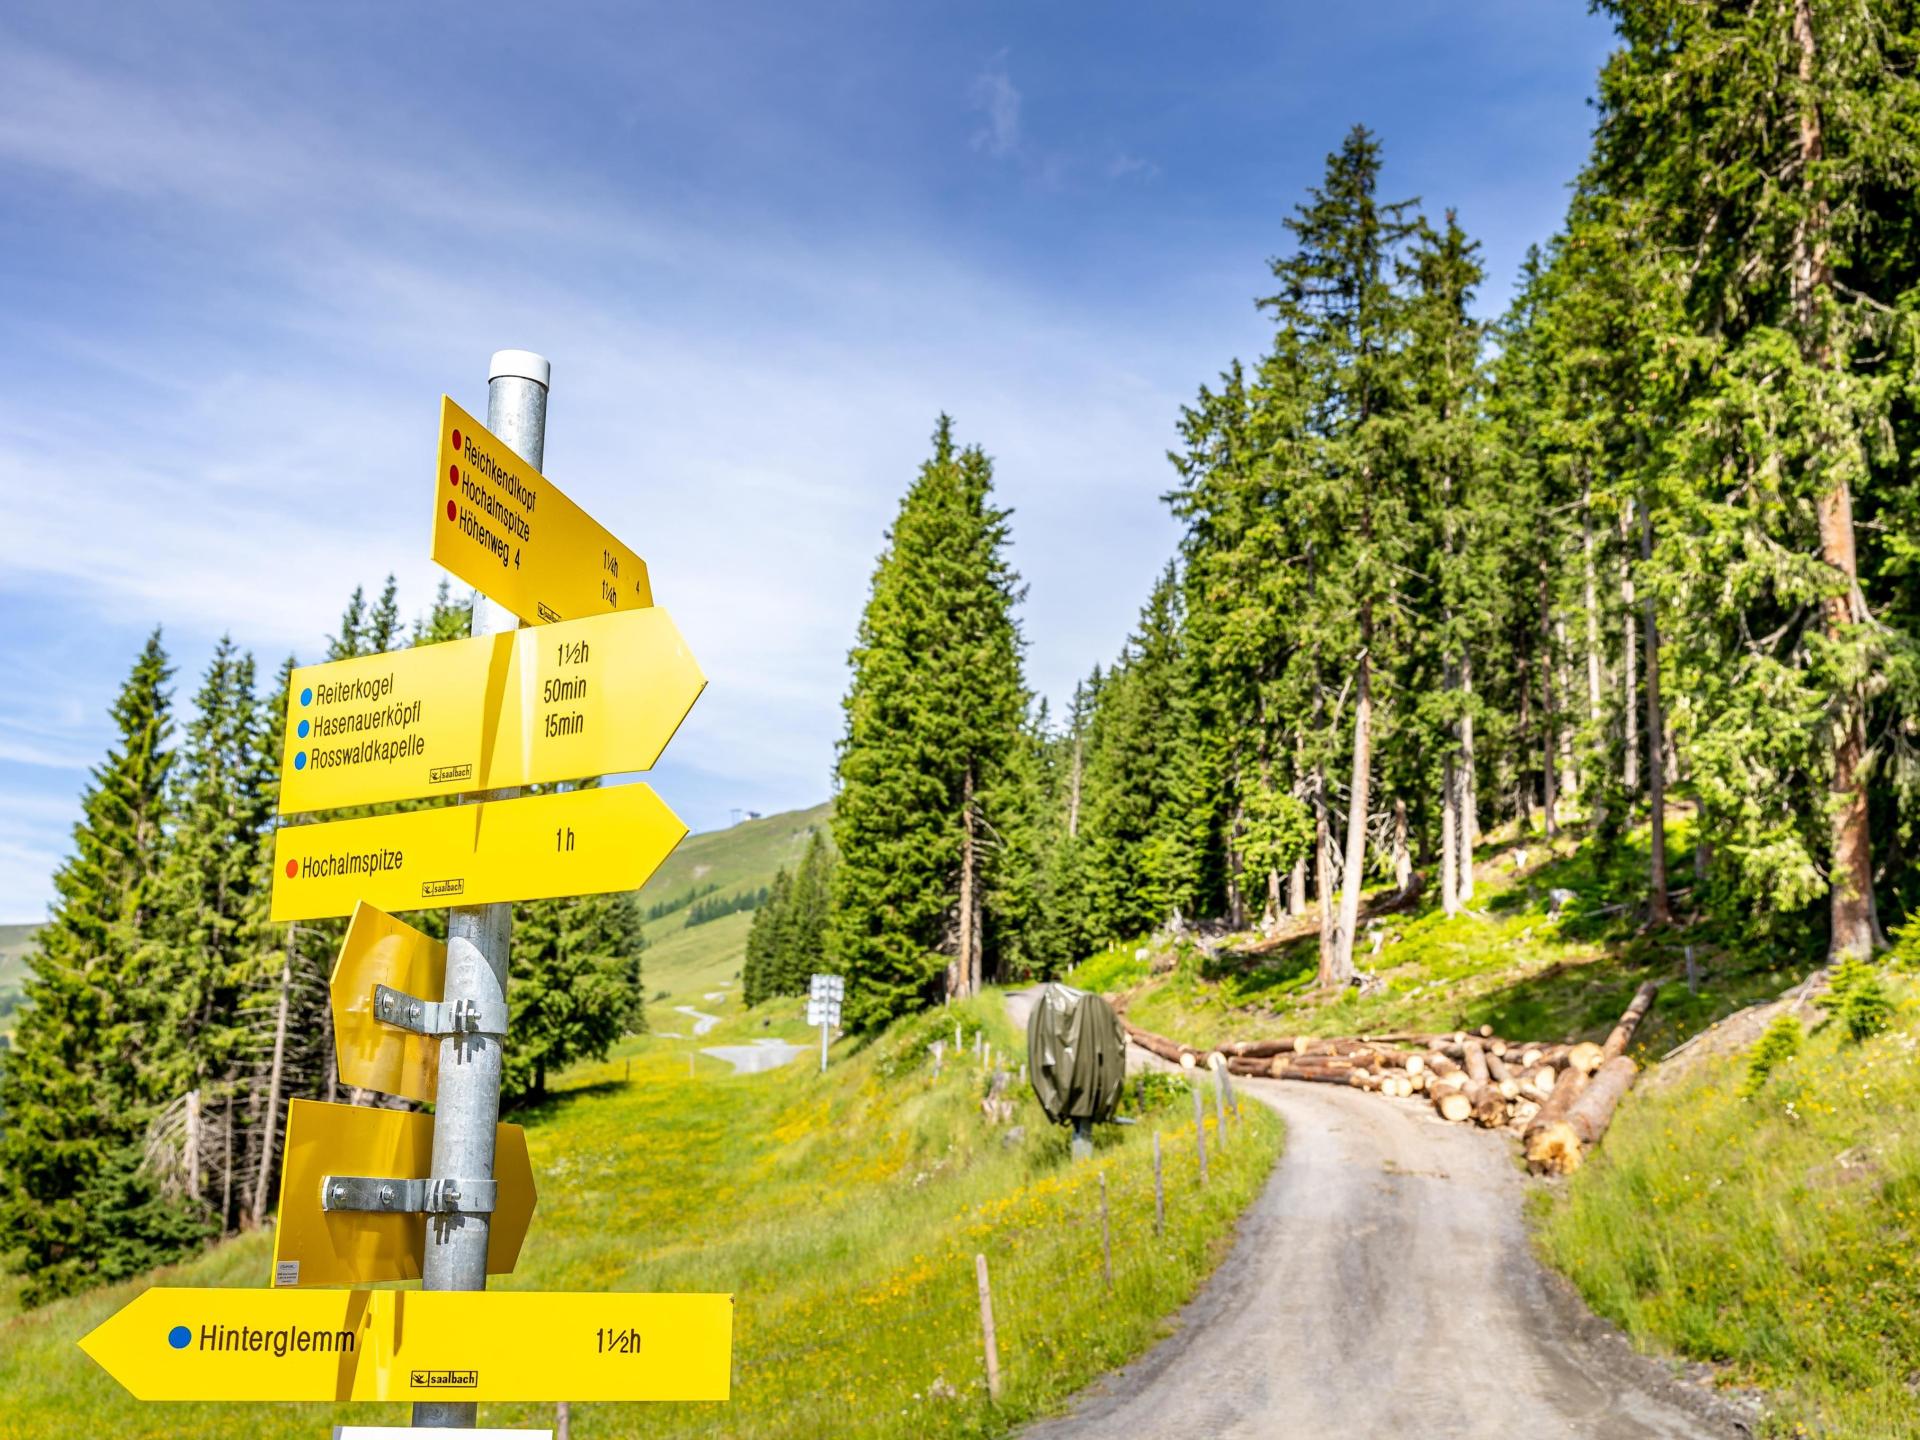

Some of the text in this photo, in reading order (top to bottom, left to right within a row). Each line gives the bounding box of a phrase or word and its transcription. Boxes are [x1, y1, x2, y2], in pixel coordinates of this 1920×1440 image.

[463, 436, 537, 513] Reichkendlkopf
[461, 470, 530, 543] Hochalmspitze
[459, 505, 521, 571] Höhenweg 4
[316, 672, 394, 706] Reiterkogel
[543, 675, 587, 704] 50min
[313, 700, 421, 739] Hasenauerköpfl
[545, 710, 584, 738] 15min
[310, 733, 425, 770] Rosswaldkapelle
[441, 765, 470, 779] saalbach
[302, 848, 403, 879] Hochalmspitze
[434, 879, 462, 893] saalbach
[199, 1324, 355, 1357] Hinterglemm
[430, 1371, 475, 1384] saalbach
